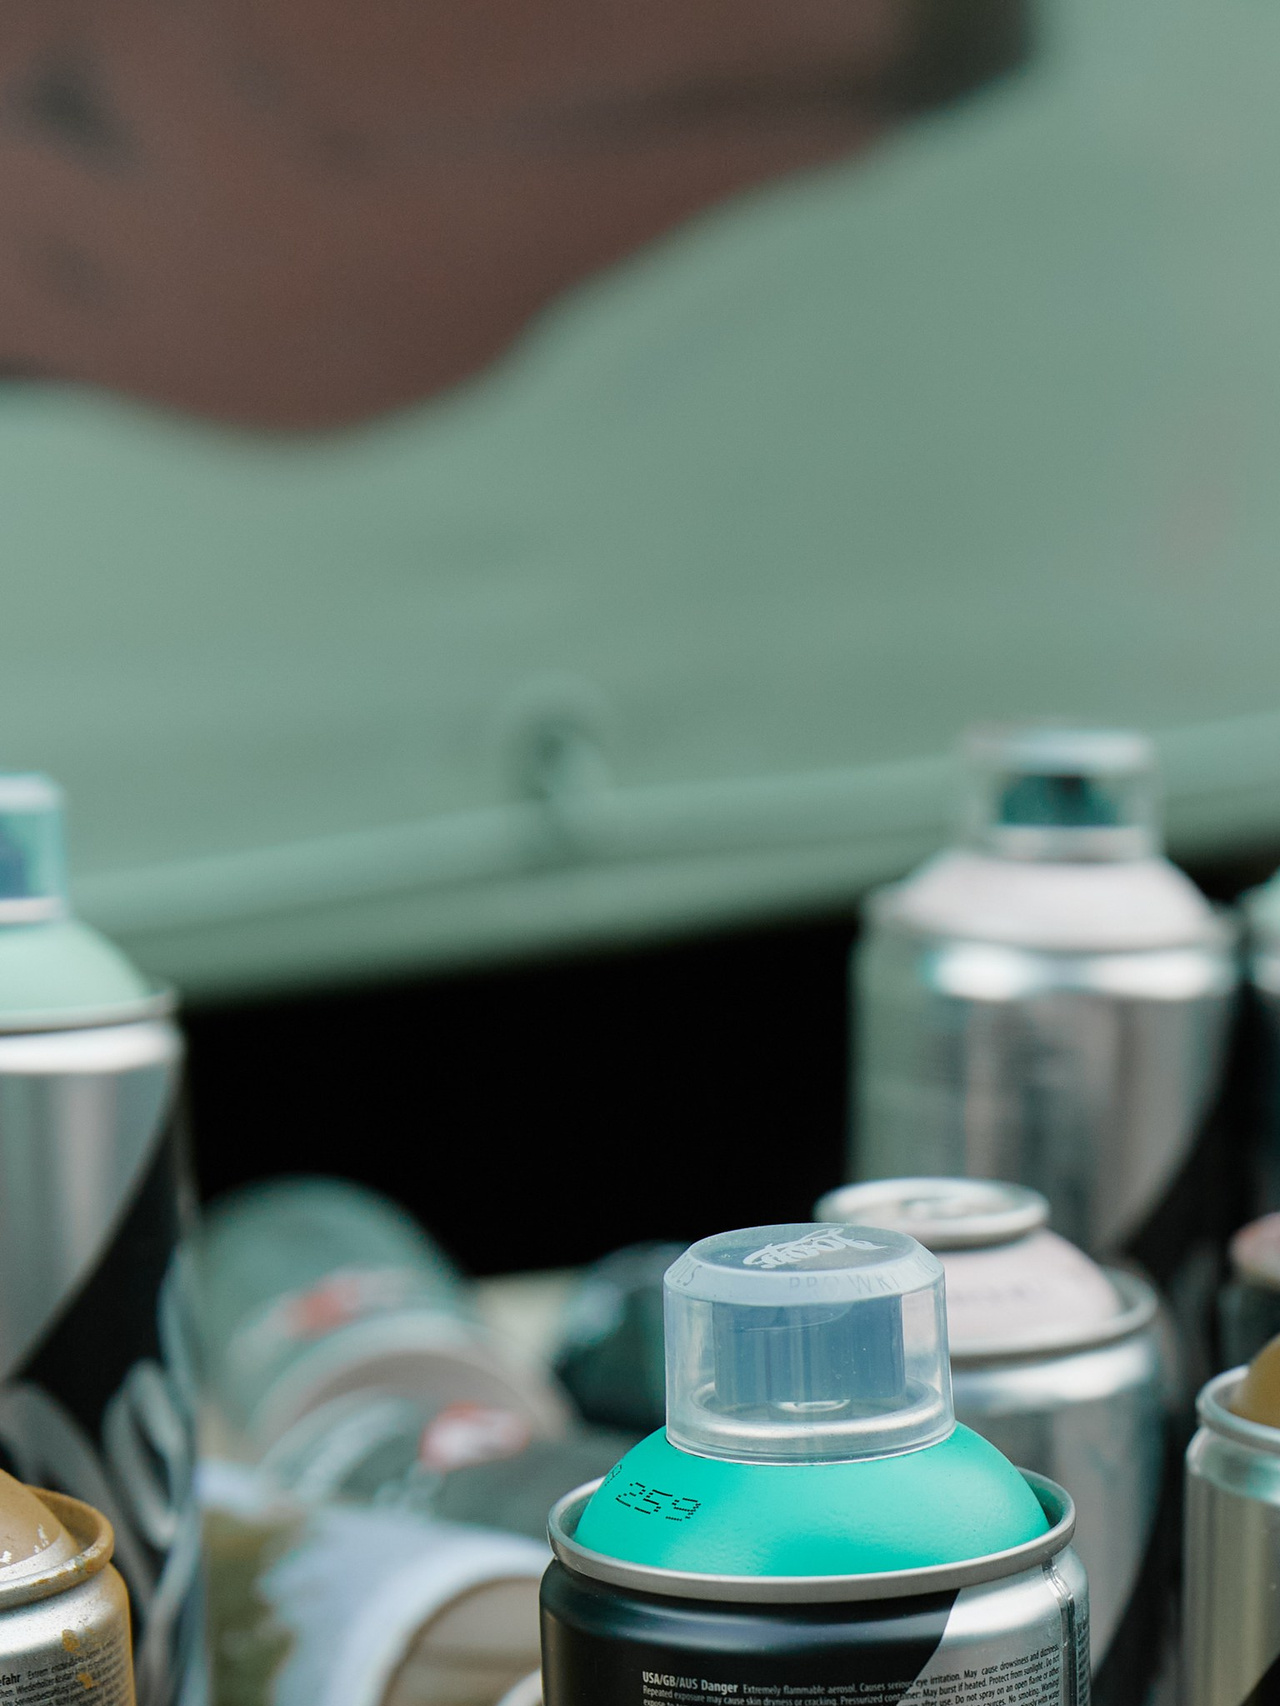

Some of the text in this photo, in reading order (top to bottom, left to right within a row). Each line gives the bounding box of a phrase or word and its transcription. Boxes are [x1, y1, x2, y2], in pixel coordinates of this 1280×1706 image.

[0, 1673, 21, 1687] fahr
[642, 1671, 697, 1689] USA/GB/AUS
[701, 1678, 738, 1696] Danger
[743, 1684, 780, 1696] Extremely
[783, 1684, 824, 1693] flammable
[827, 1683, 856, 1693] aerosol.
[859, 1680, 885, 1692] Causes
[916, 1678, 927, 1689] eye
[930, 1670, 960, 1684] irritation.
[964, 1667, 976, 1681] May
[981, 1664, 997, 1675] cause
